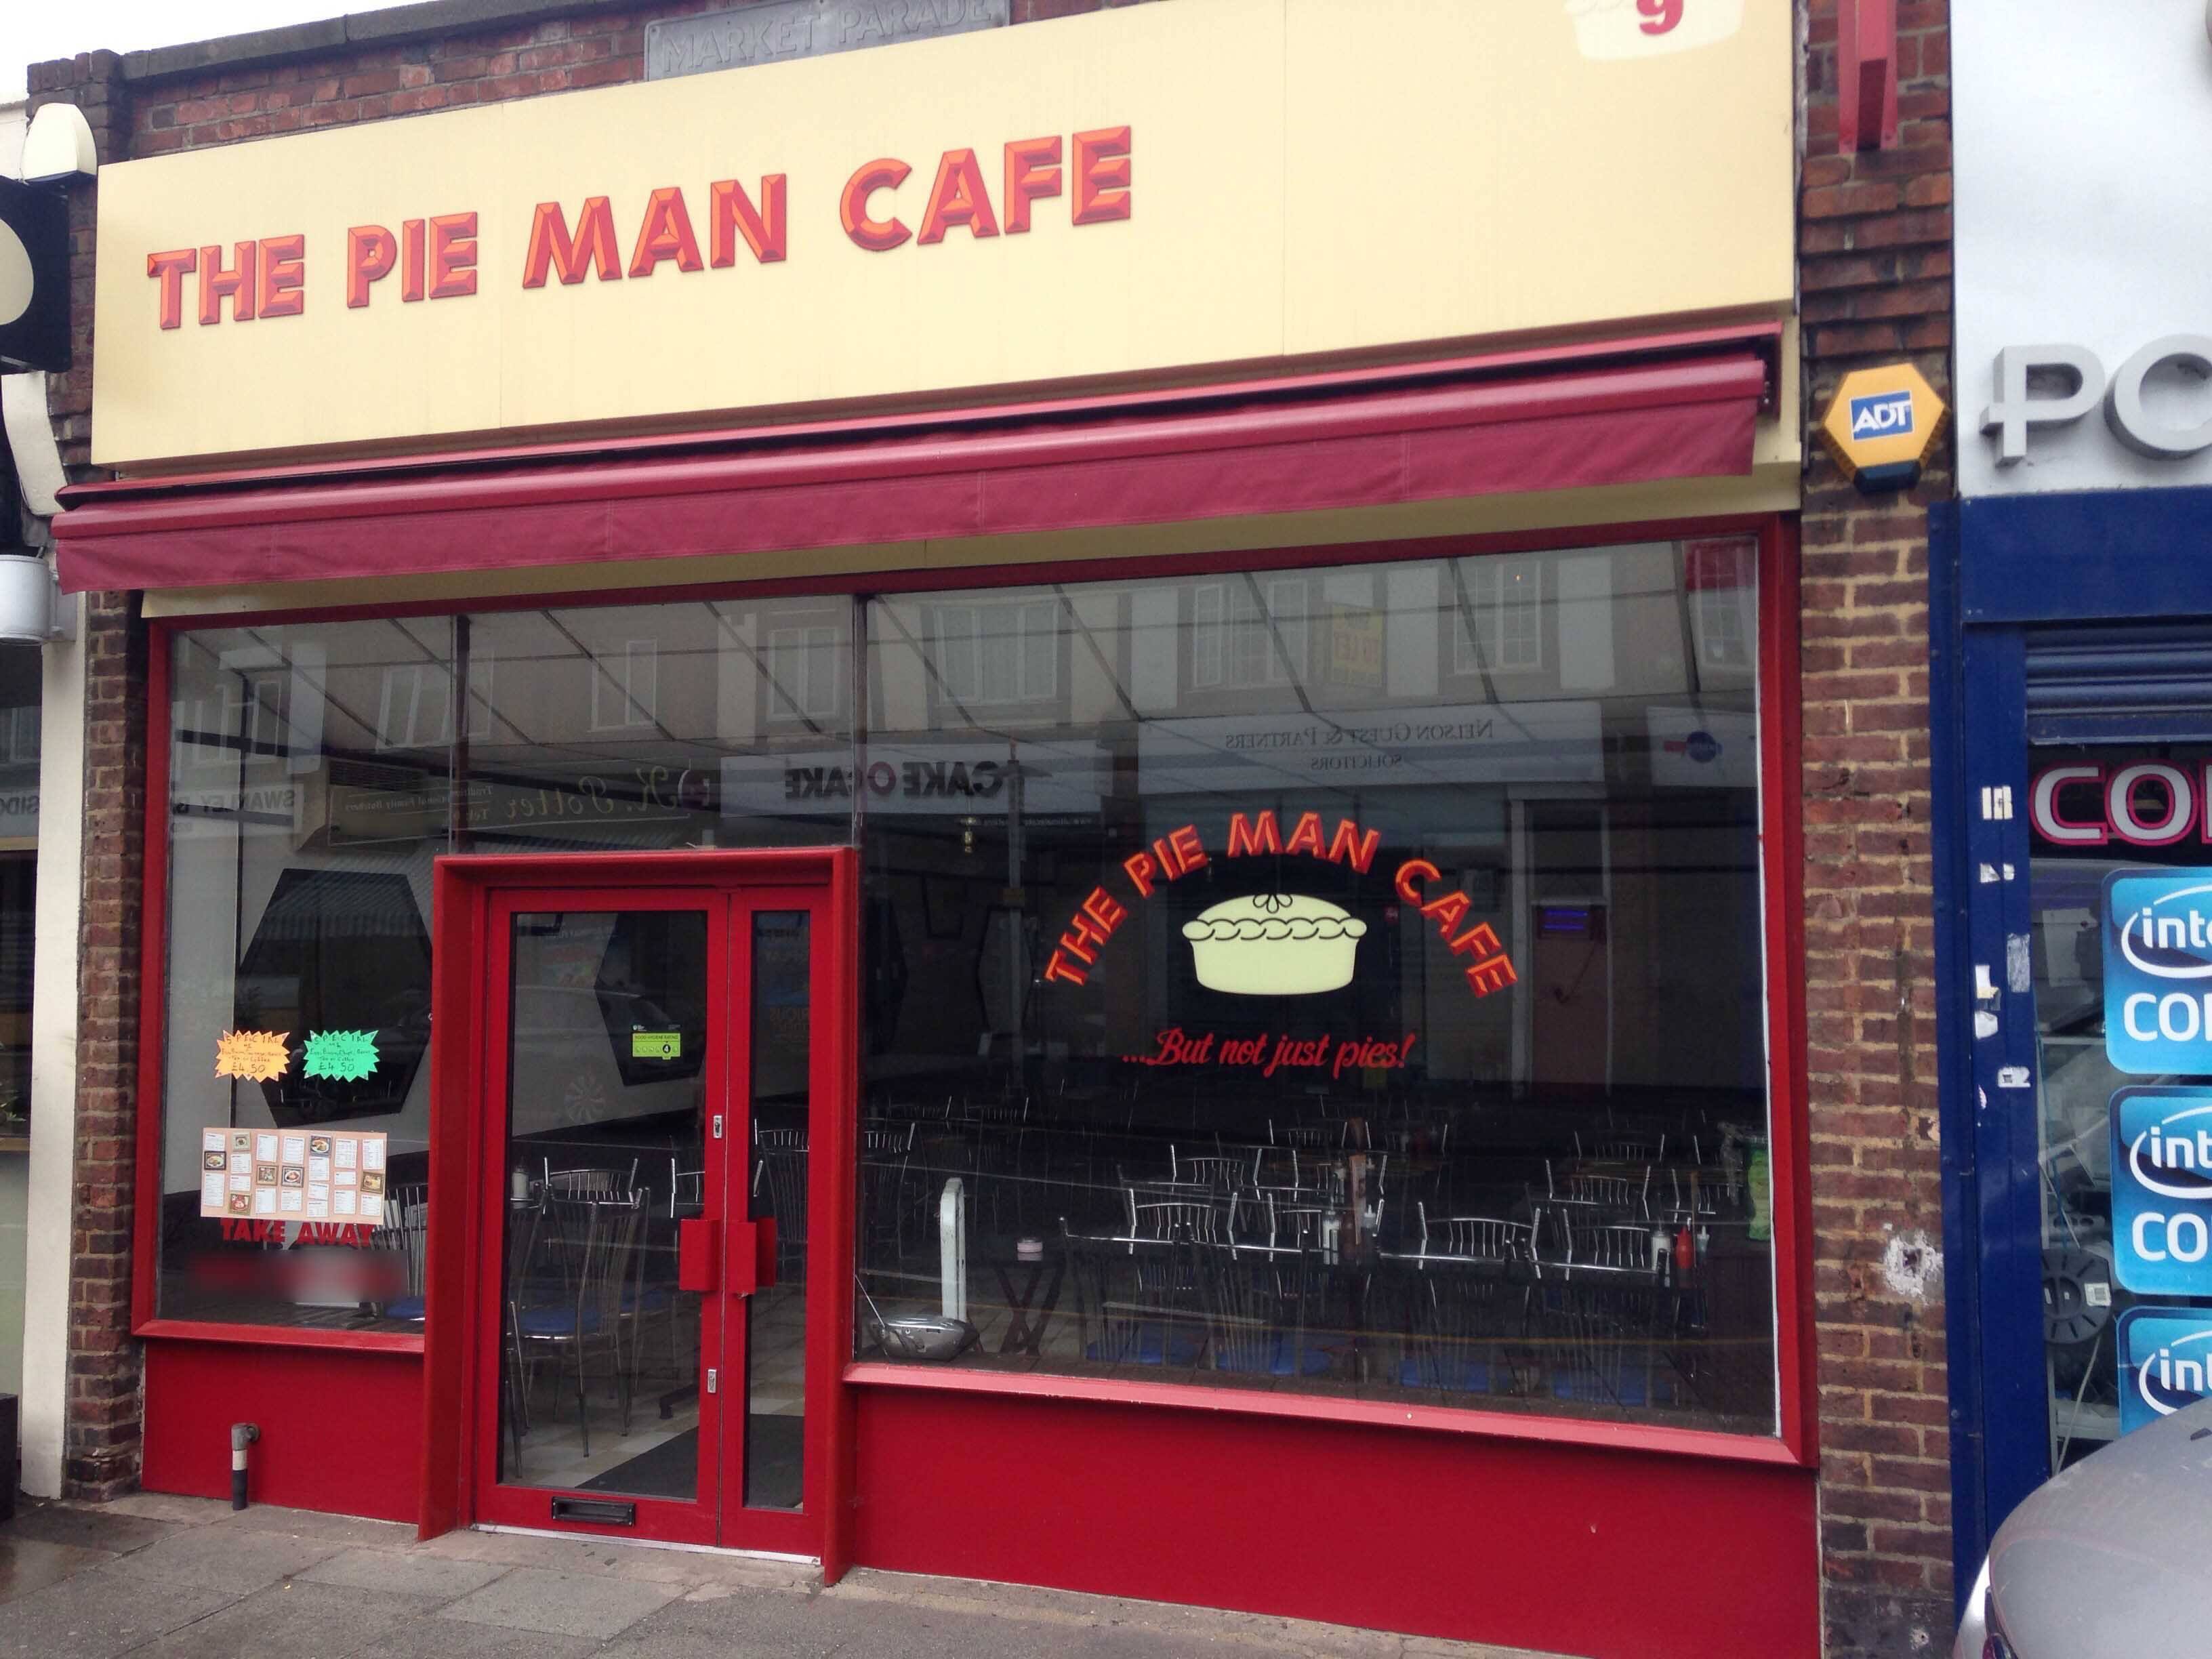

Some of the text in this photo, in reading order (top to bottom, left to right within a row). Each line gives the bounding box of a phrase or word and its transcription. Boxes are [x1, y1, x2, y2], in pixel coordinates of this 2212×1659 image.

[662, 0, 992, 73] MARKET PARADE
[146, 125, 1132, 330] THE PIE MAN CAFE
[1853, 401, 1910, 432] ADT
[2028, 759, 2212, 846] CO
[1044, 810, 1518, 999] THE PIE MAN CAFE
[2142, 907, 2212, 949] int
[313, 1033, 369, 1045] SPECIAL
[2124, 993, 2212, 1042] CO
[1219, 1034, 1267, 1065] not
[1263, 1033, 1330, 1079] just
[1334, 1033, 1417, 1080] pies!
[220, 1218, 375, 1247] TAKE AWAY
[2132, 1212, 2212, 1263] CO
